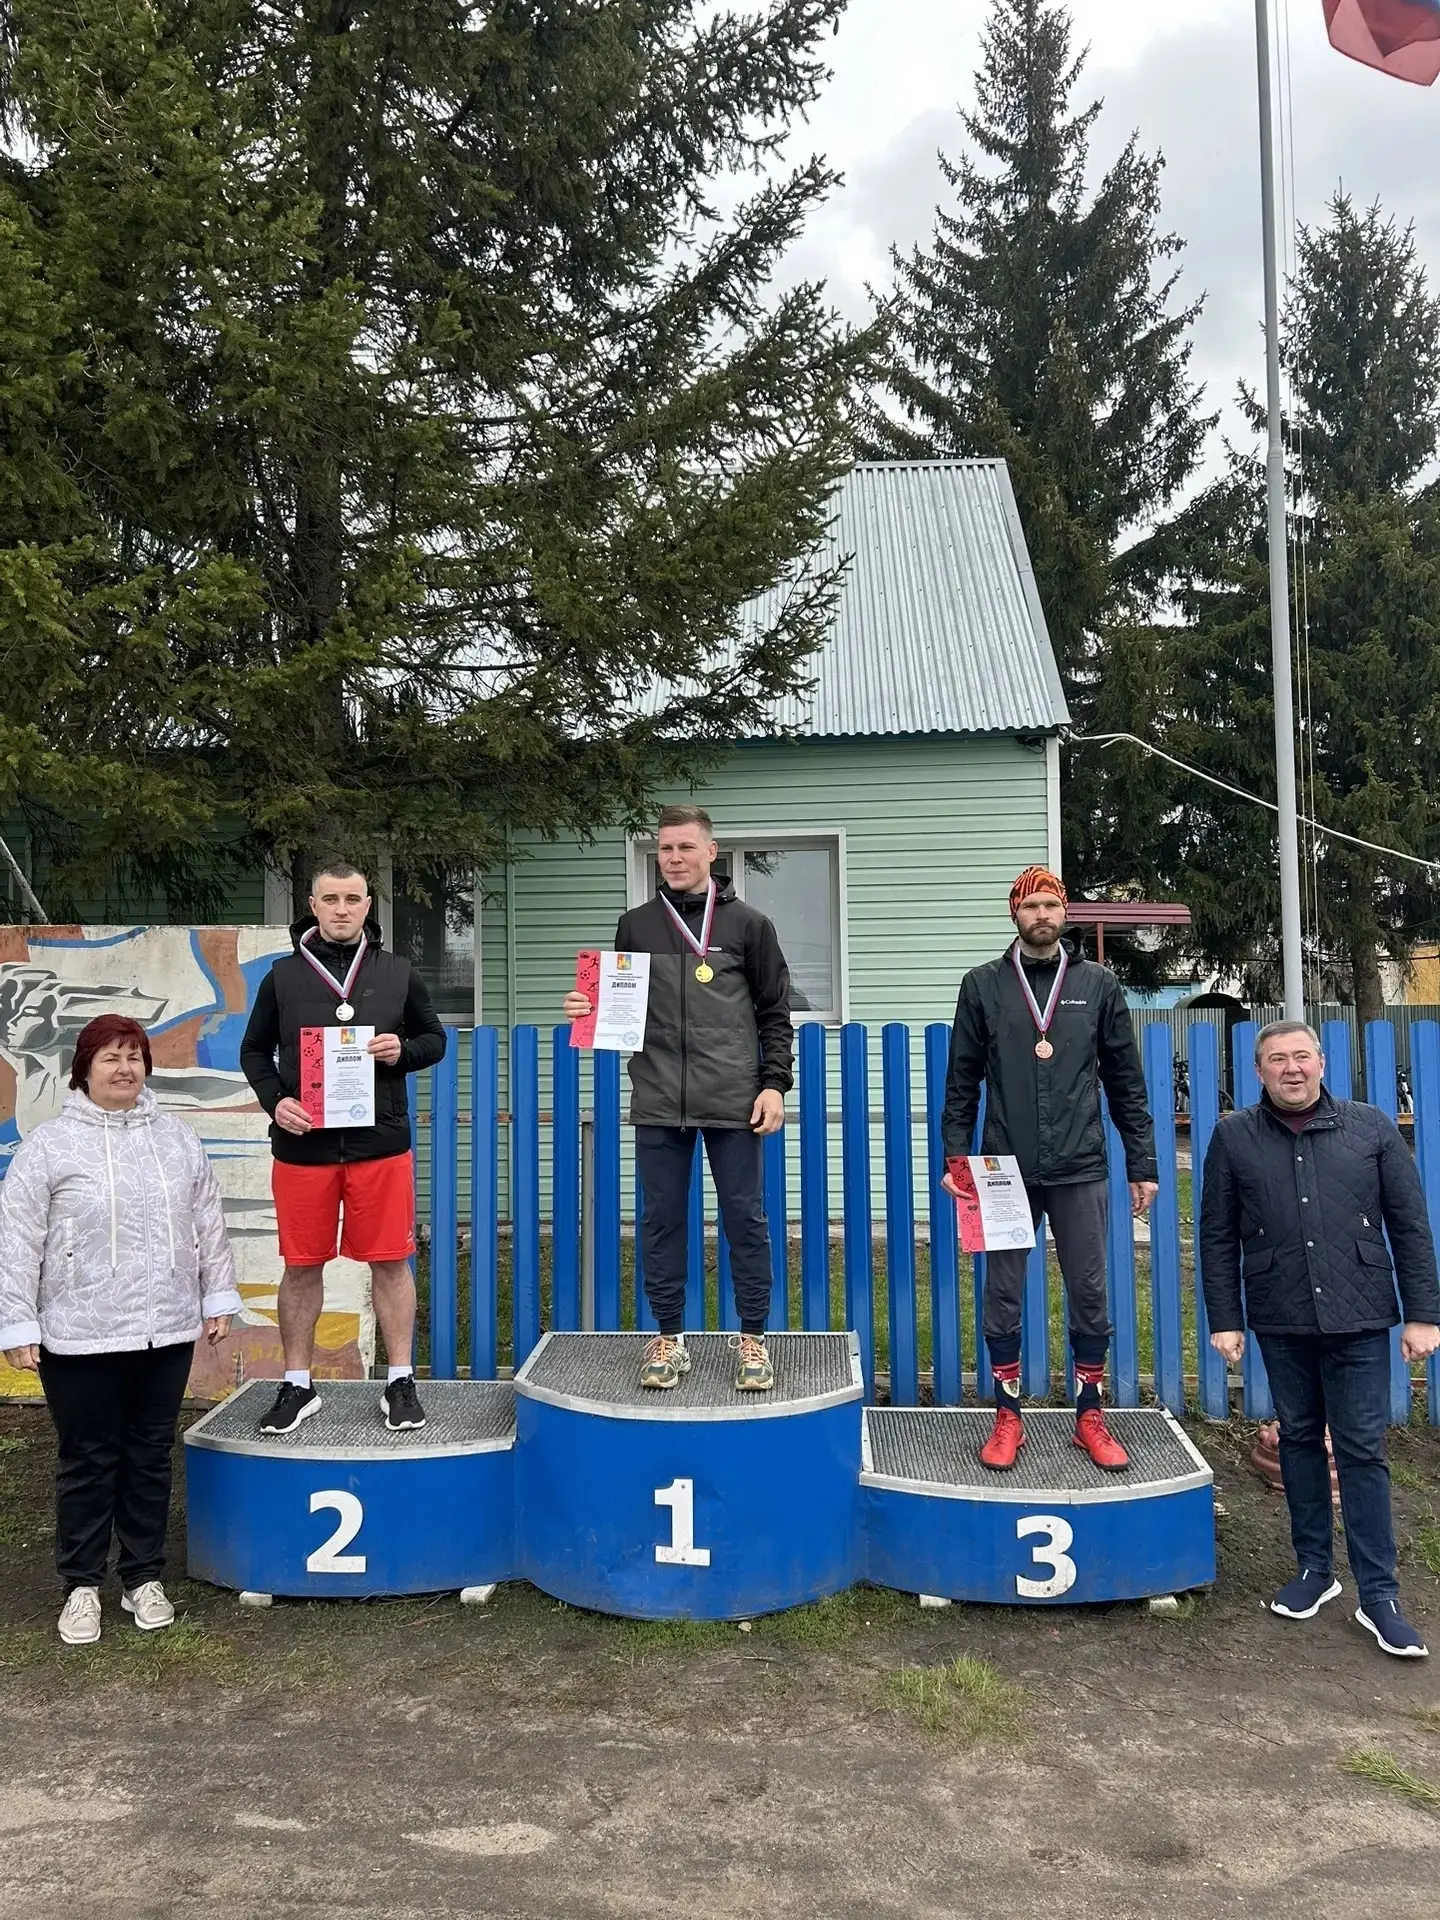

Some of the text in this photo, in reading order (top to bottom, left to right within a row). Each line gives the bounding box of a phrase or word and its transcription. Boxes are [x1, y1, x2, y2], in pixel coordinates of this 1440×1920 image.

[611, 981, 637, 989] ДИПЛОМ
[336, 1055, 362, 1063] ДИПЛОМ
[307, 1489, 367, 1573] 2
[655, 1478, 711, 1567] 1
[1016, 1515, 1077, 1598] 3
